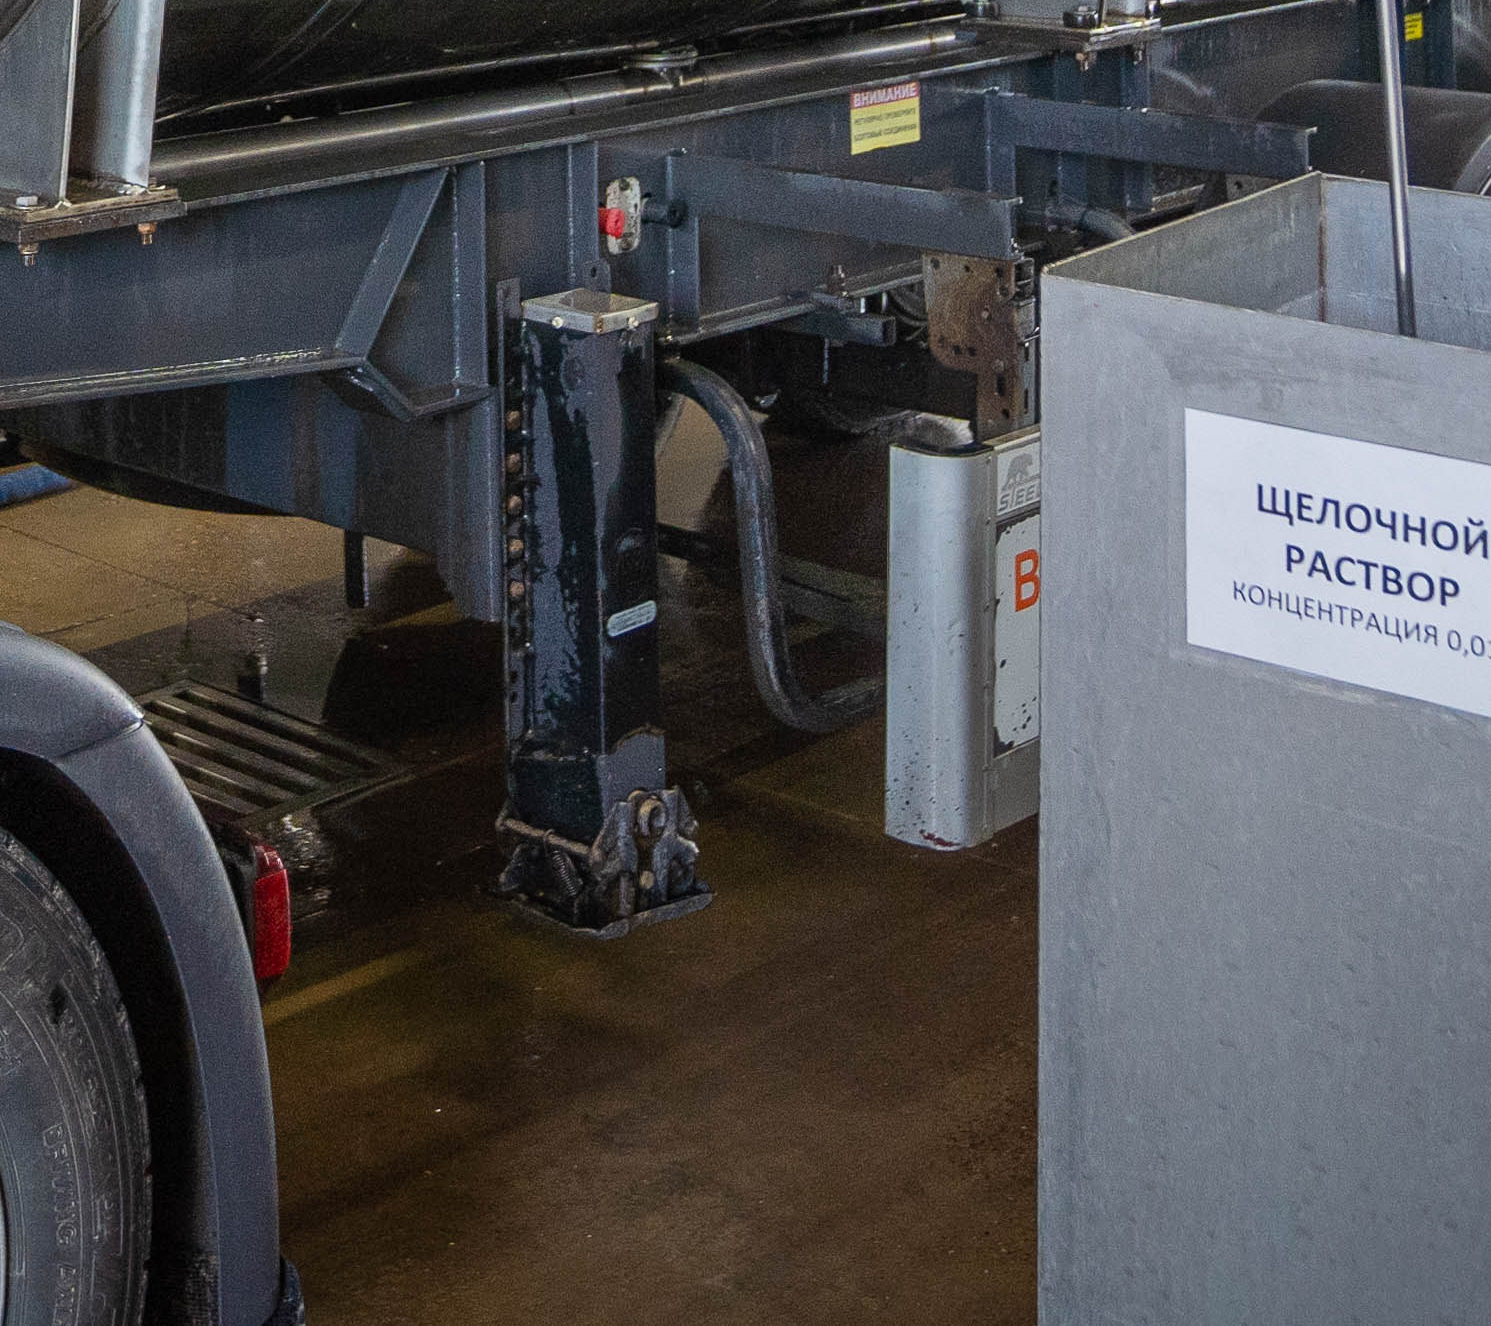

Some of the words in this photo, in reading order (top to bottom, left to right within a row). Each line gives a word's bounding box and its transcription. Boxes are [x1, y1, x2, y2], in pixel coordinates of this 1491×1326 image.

[853, 82, 918, 109] ВНИМАНИЕ
[1257, 483, 1489, 560] ЩЕЛОЧНОЙ
[1285, 543, 1460, 607] РАСТВОР
[1233, 580, 1438, 646] КОНЦЕНТРАЦИЯ
